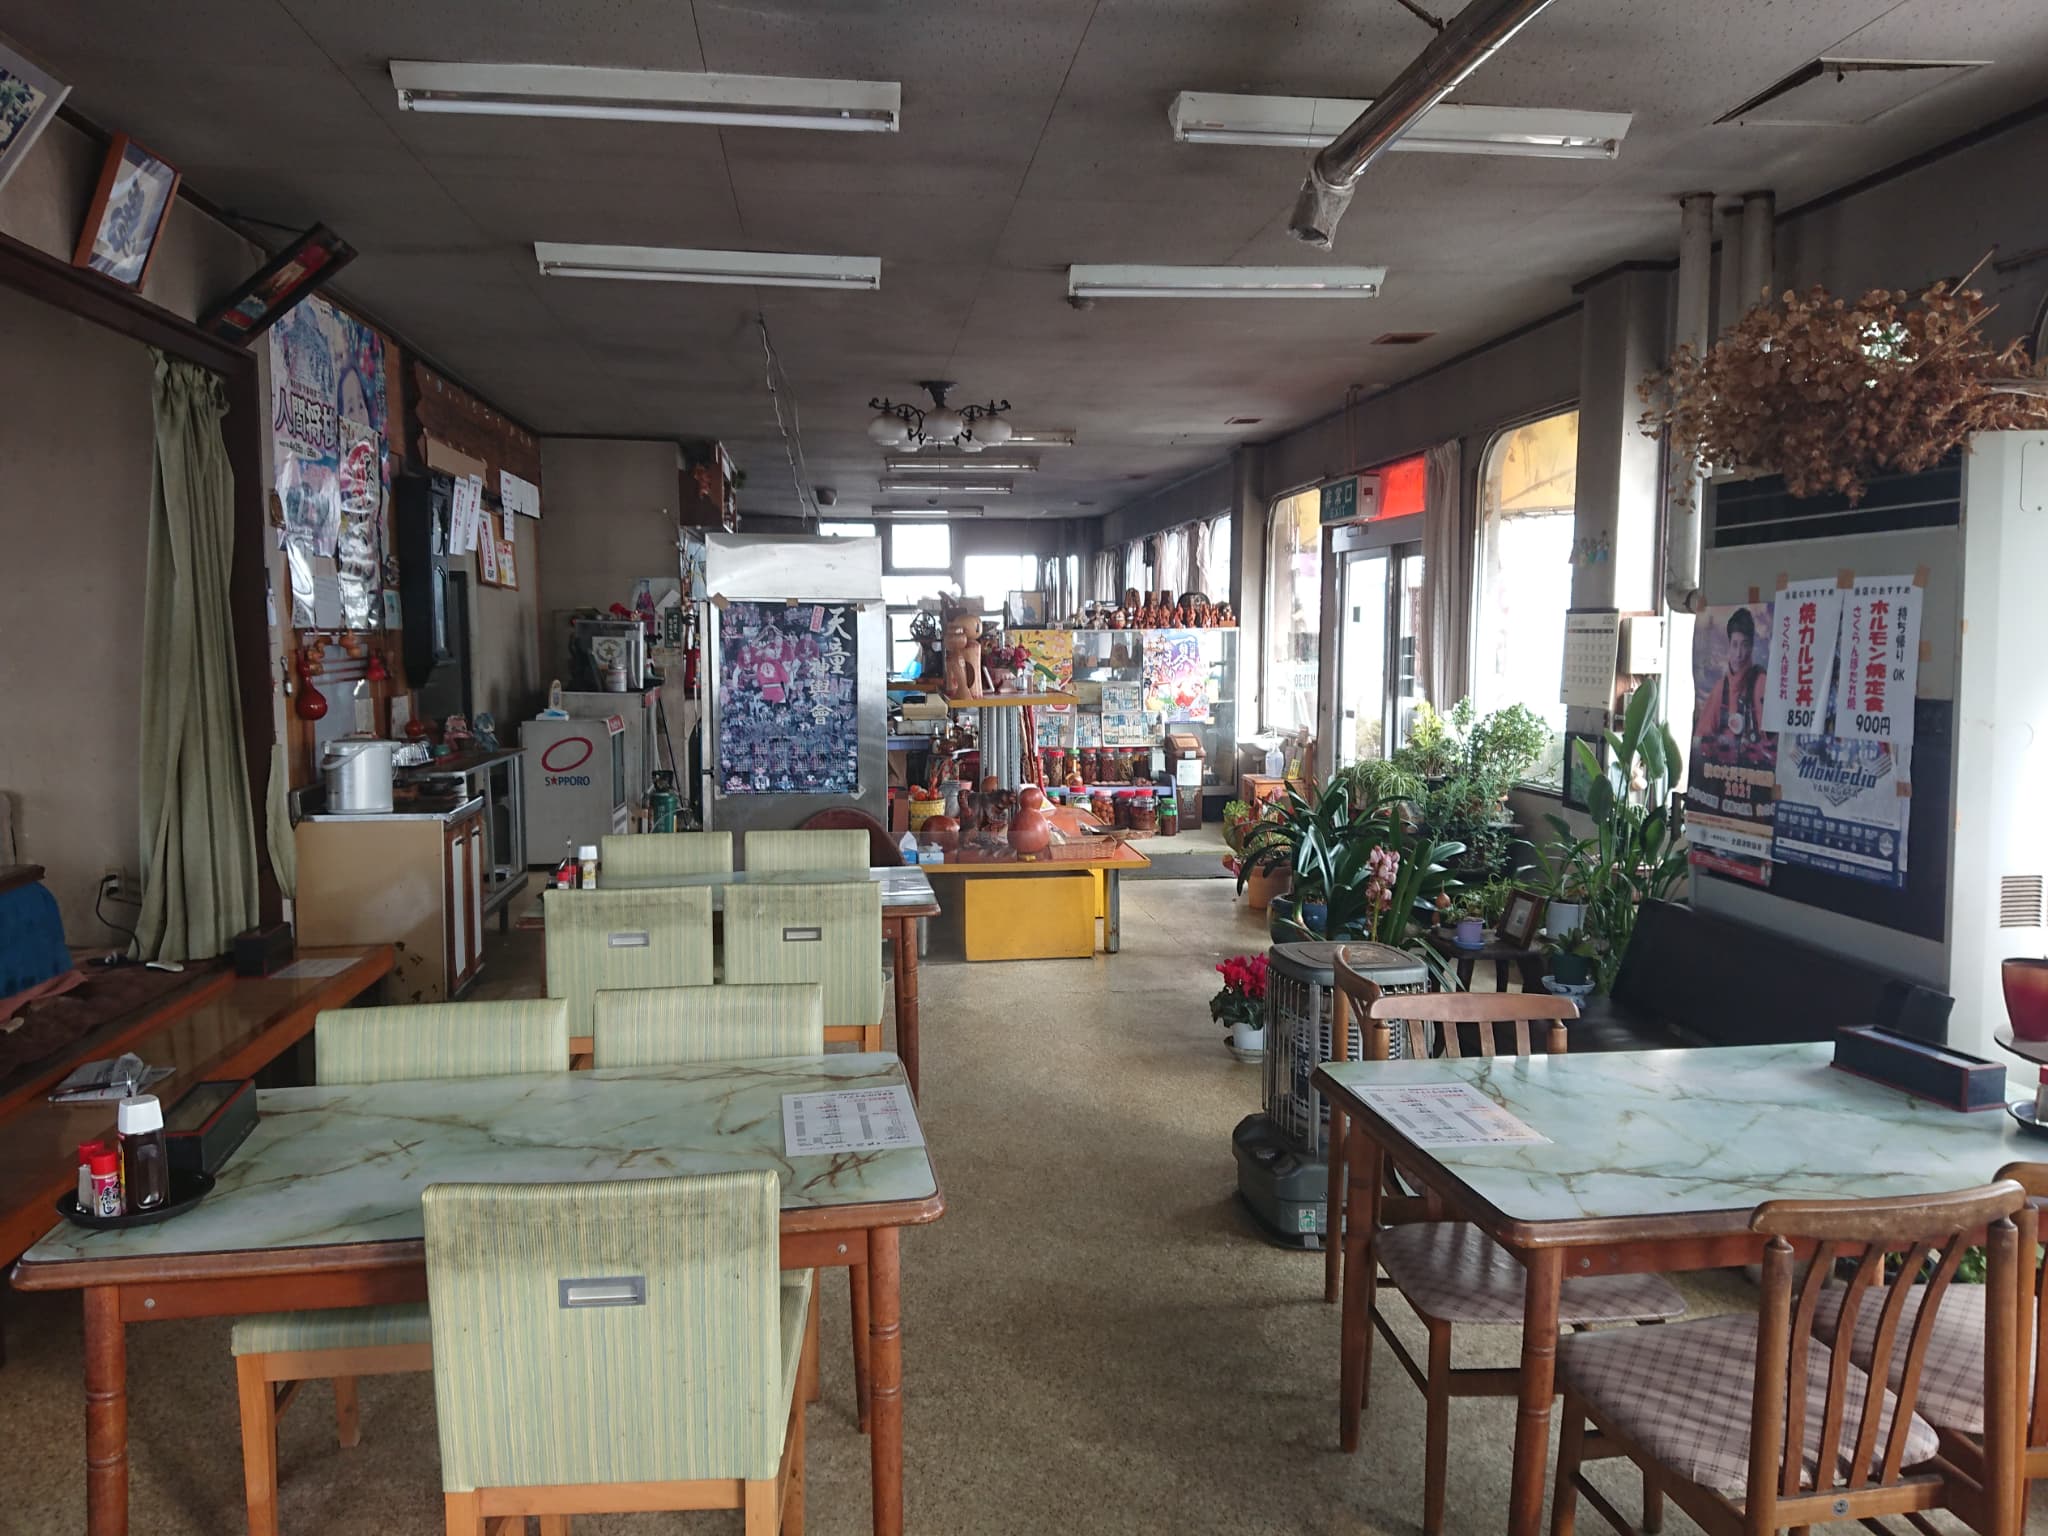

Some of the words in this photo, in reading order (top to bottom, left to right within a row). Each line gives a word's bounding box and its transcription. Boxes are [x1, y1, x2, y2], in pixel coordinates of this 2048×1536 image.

[822, 606, 852, 675] 天童
[1795, 601, 1817, 708] 焼カルビ丼
[1864, 600, 1889, 712] ホルモン焼定食
[1892, 668, 1905, 681] OK
[1855, 714, 1891, 736] 900円
[1798, 755, 1878, 789] Montedio
